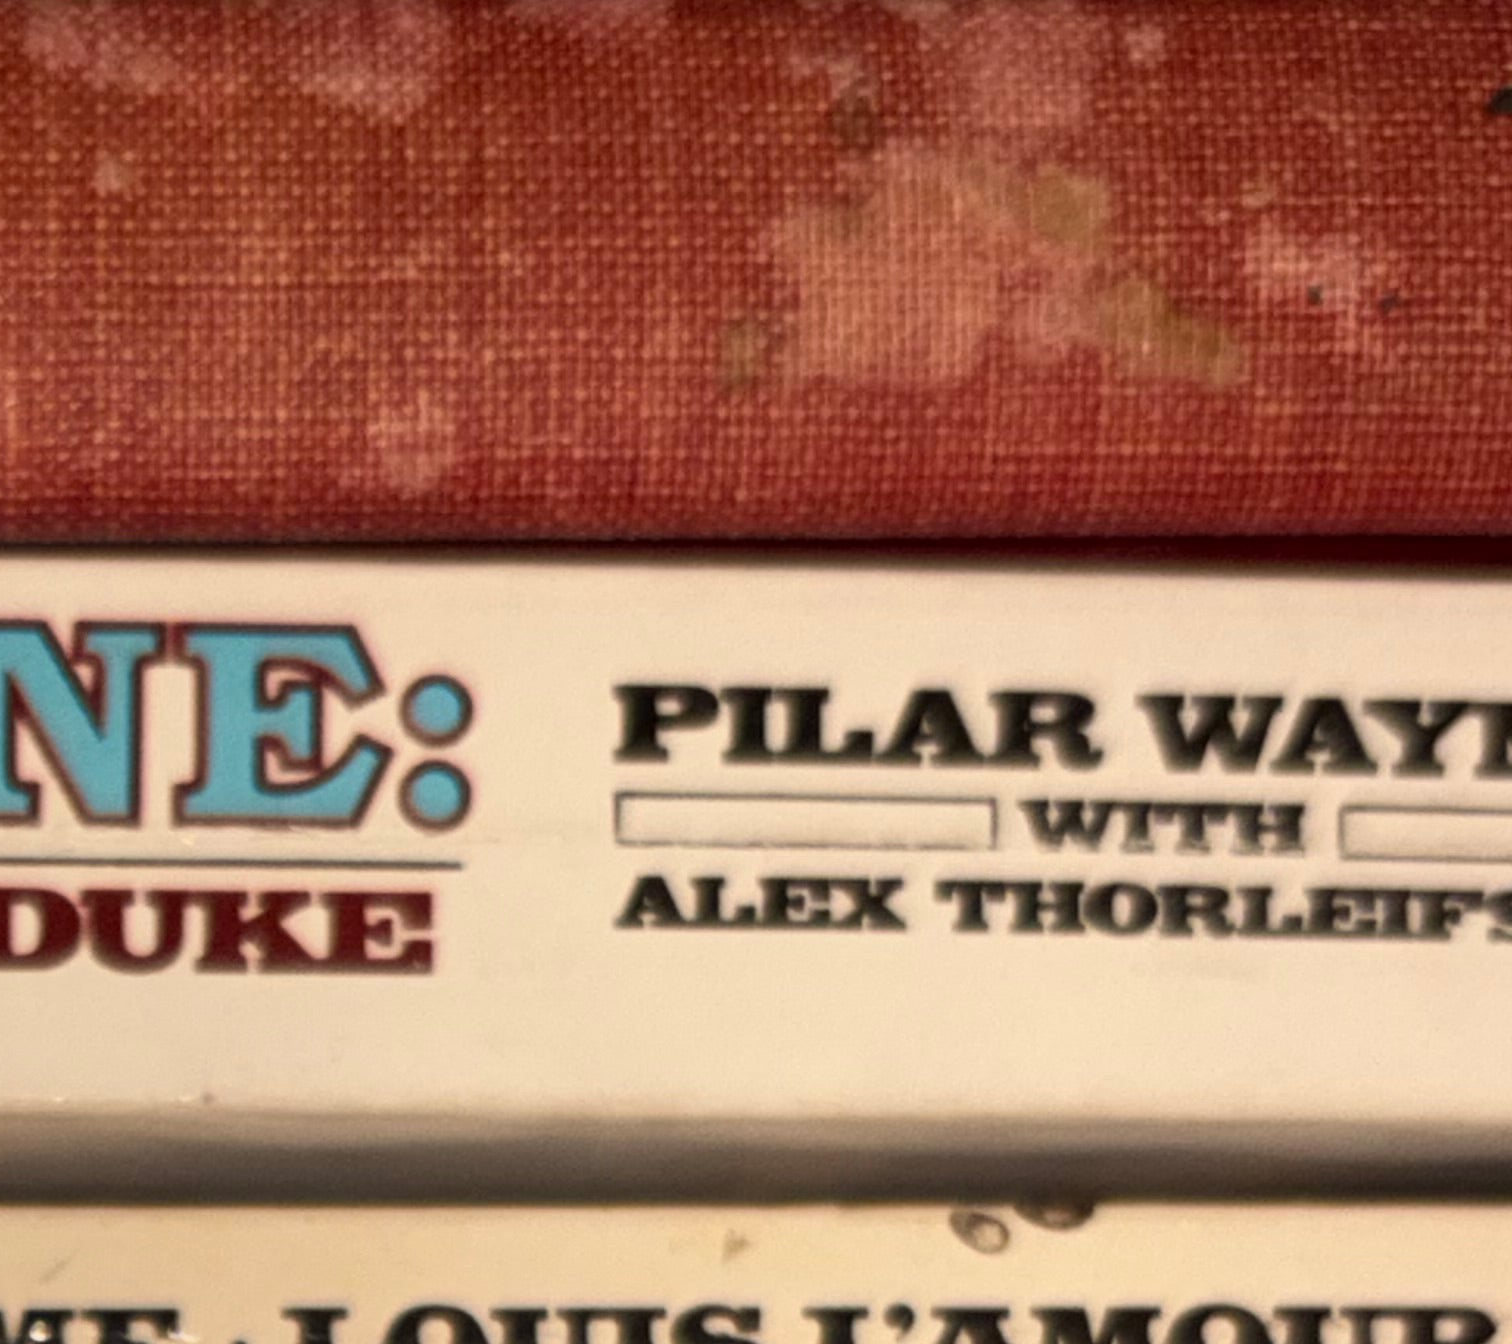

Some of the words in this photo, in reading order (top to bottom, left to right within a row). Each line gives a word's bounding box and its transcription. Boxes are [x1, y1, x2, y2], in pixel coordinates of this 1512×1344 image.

[616, 684, 1103, 768] PILAR
[1022, 799, 1305, 851] WITH
[618, 876, 905, 929] ALEX
